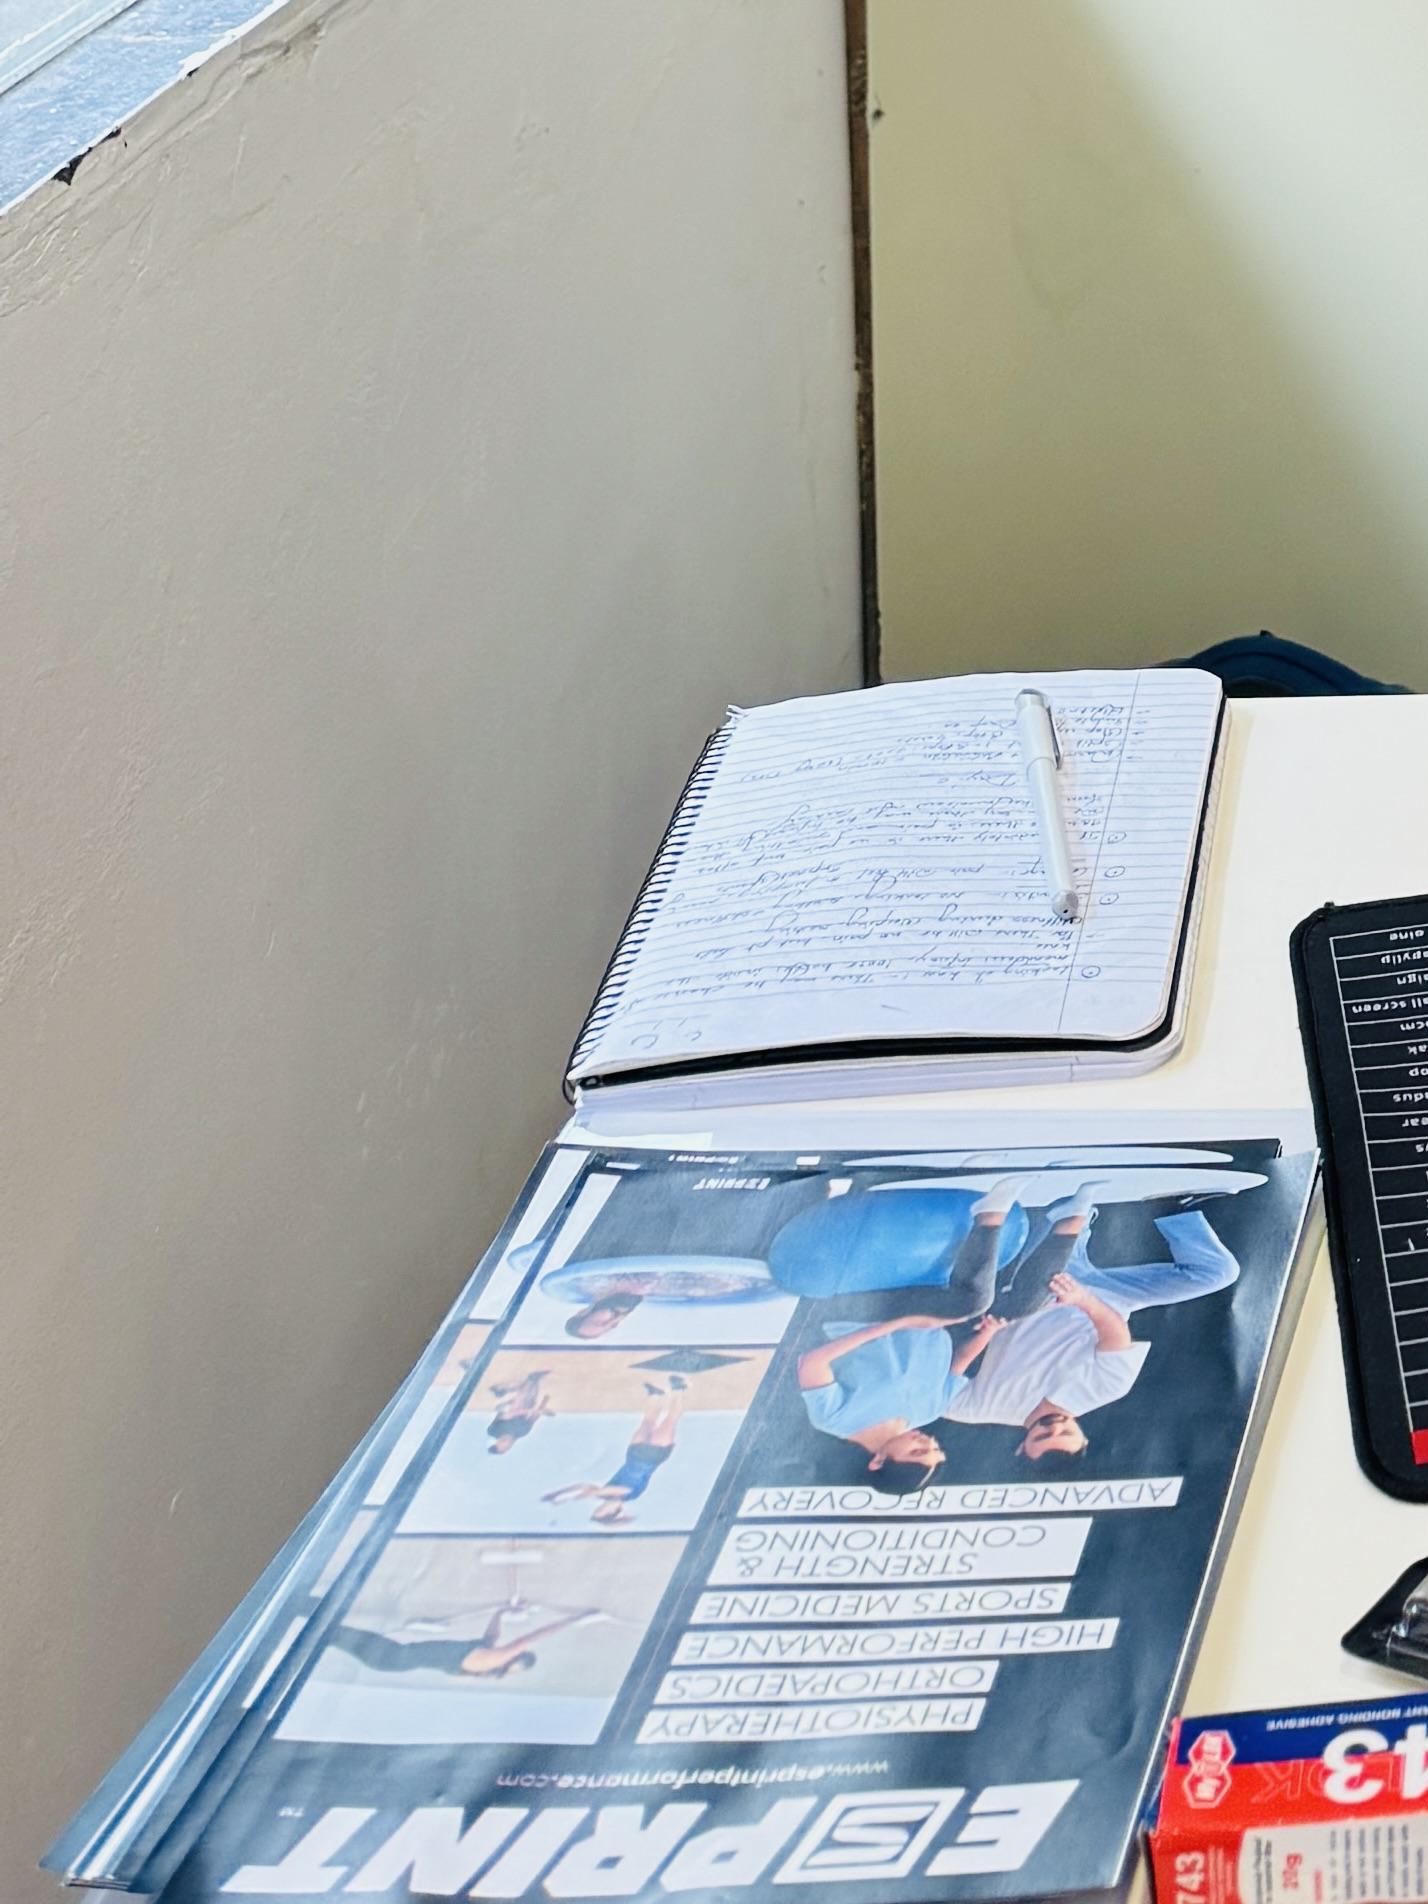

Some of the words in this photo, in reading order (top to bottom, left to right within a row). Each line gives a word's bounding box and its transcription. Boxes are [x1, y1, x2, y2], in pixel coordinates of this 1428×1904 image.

[960, 1480, 1173, 1509] ADVANCED
[733, 1524, 1049, 1553] CONDITIONING
[736, 1557, 763, 1578] &
[773, 1552, 979, 1577] STRENGTH
[702, 1592, 902, 1619] MEDICINE
[913, 1587, 1061, 1616] SPORTS
[684, 1628, 988, 1661] PERFORMANCE
[998, 1623, 1108, 1649] HIGH
[668, 1665, 986, 1699] ORTHOPAEDICS
[648, 1701, 975, 1738] PHYSIOTHERAPY
[1266, 1713, 1335, 1732] ADHESIVE
[218, 1778, 1082, 1897] ESPRINT
